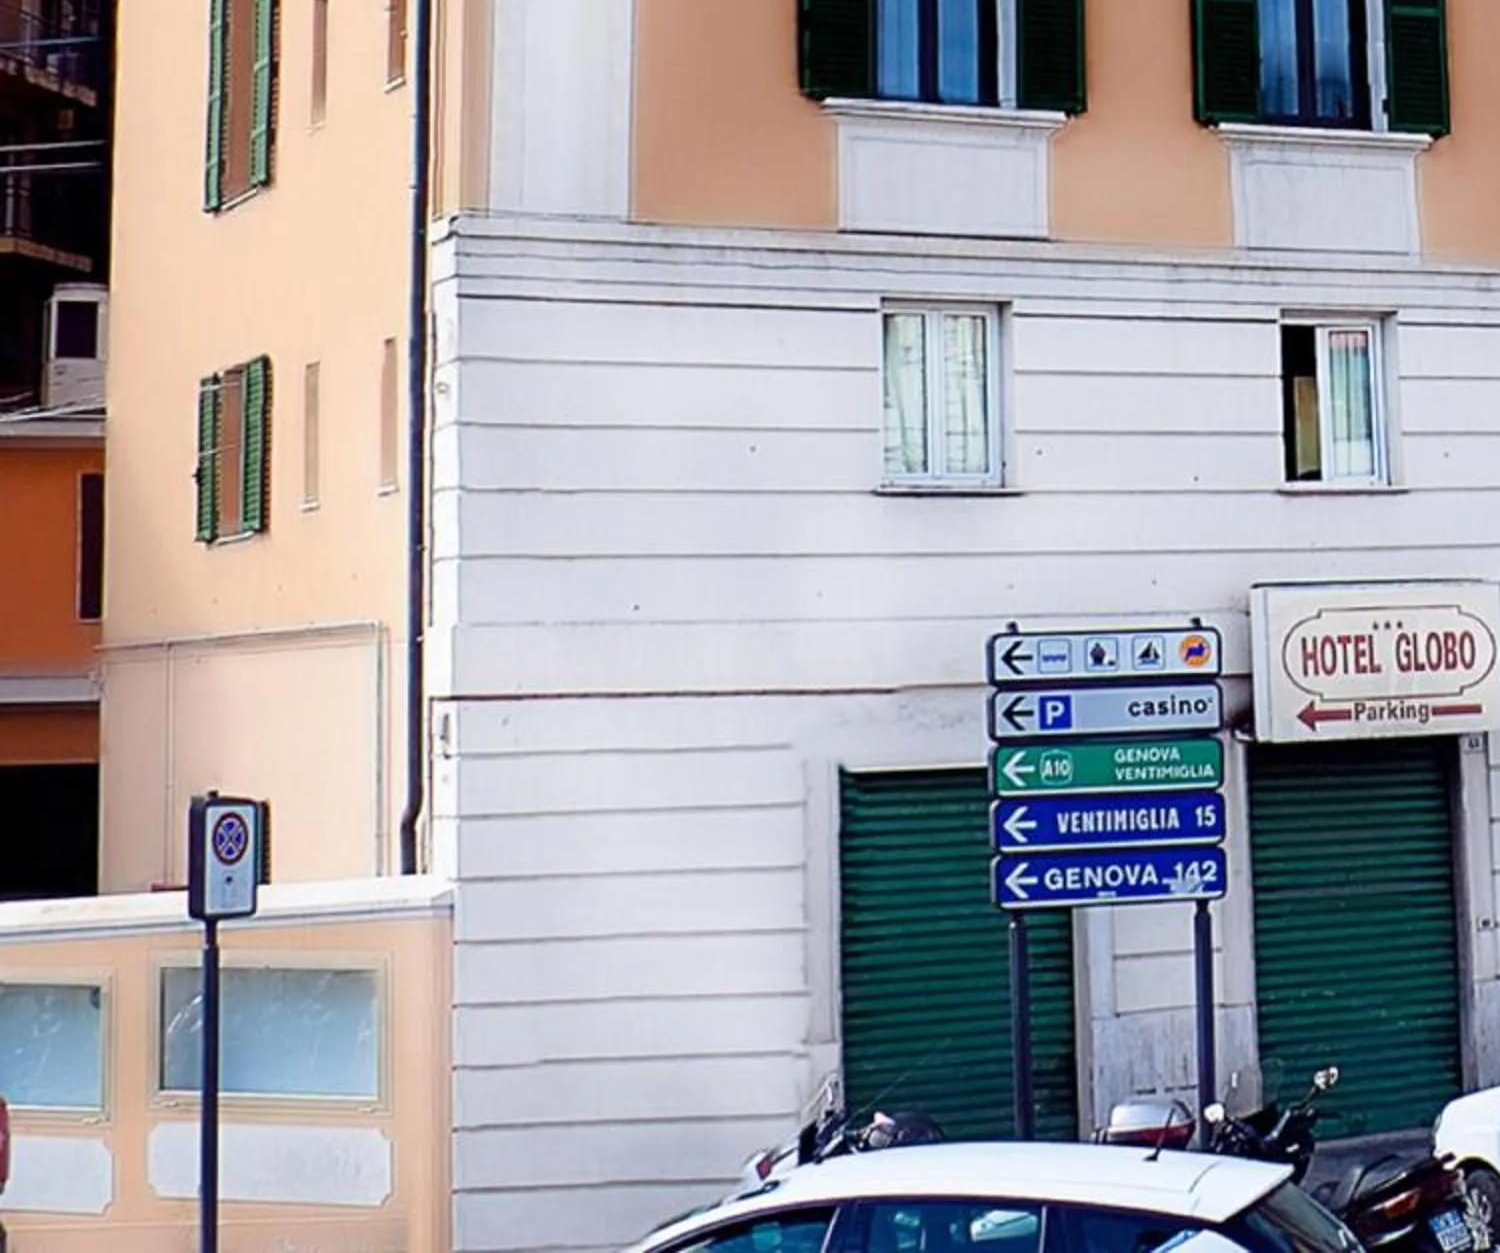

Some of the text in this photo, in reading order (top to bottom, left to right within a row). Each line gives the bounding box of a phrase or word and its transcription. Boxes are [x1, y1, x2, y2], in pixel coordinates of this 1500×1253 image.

[1301, 630, 1477, 678] HOTEL GLOBO
[1353, 700, 1431, 724] Parking
[1114, 746, 1181, 764] GENOVA
[1042, 760, 1216, 782] A10 VENTIMIGLIA
[1056, 804, 1217, 834] VENTIMIGLIA 15
[1043, 859, 1218, 891] GENOVA 142
